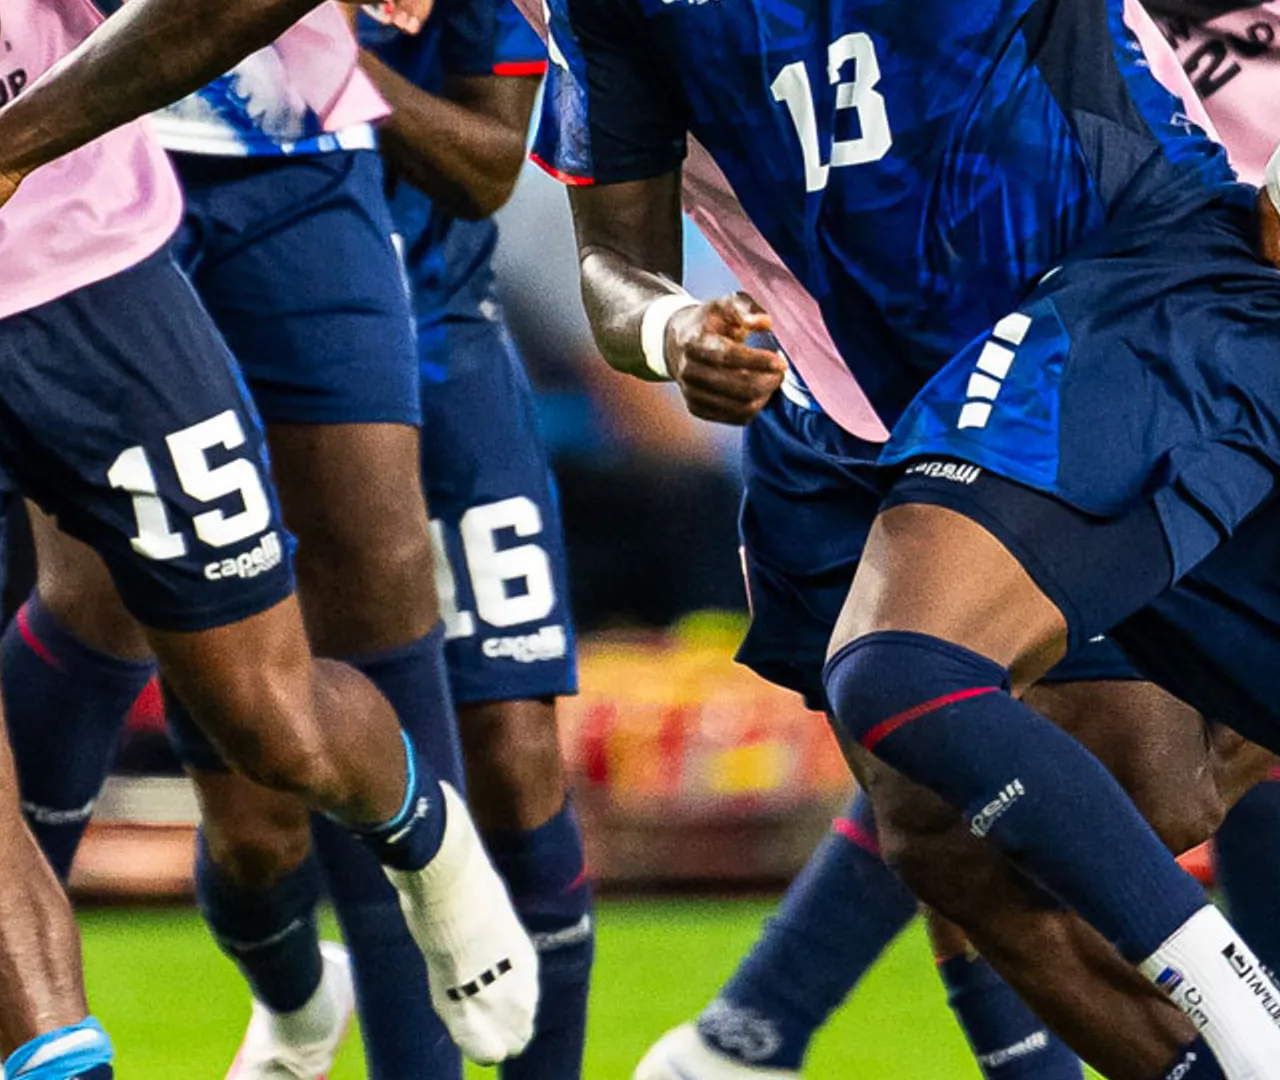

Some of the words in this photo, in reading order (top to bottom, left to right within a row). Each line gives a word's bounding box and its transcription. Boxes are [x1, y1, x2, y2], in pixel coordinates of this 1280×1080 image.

[769, 32, 893, 193] 13
[107, 409, 271, 560] 15
[429, 496, 556, 637] 16
